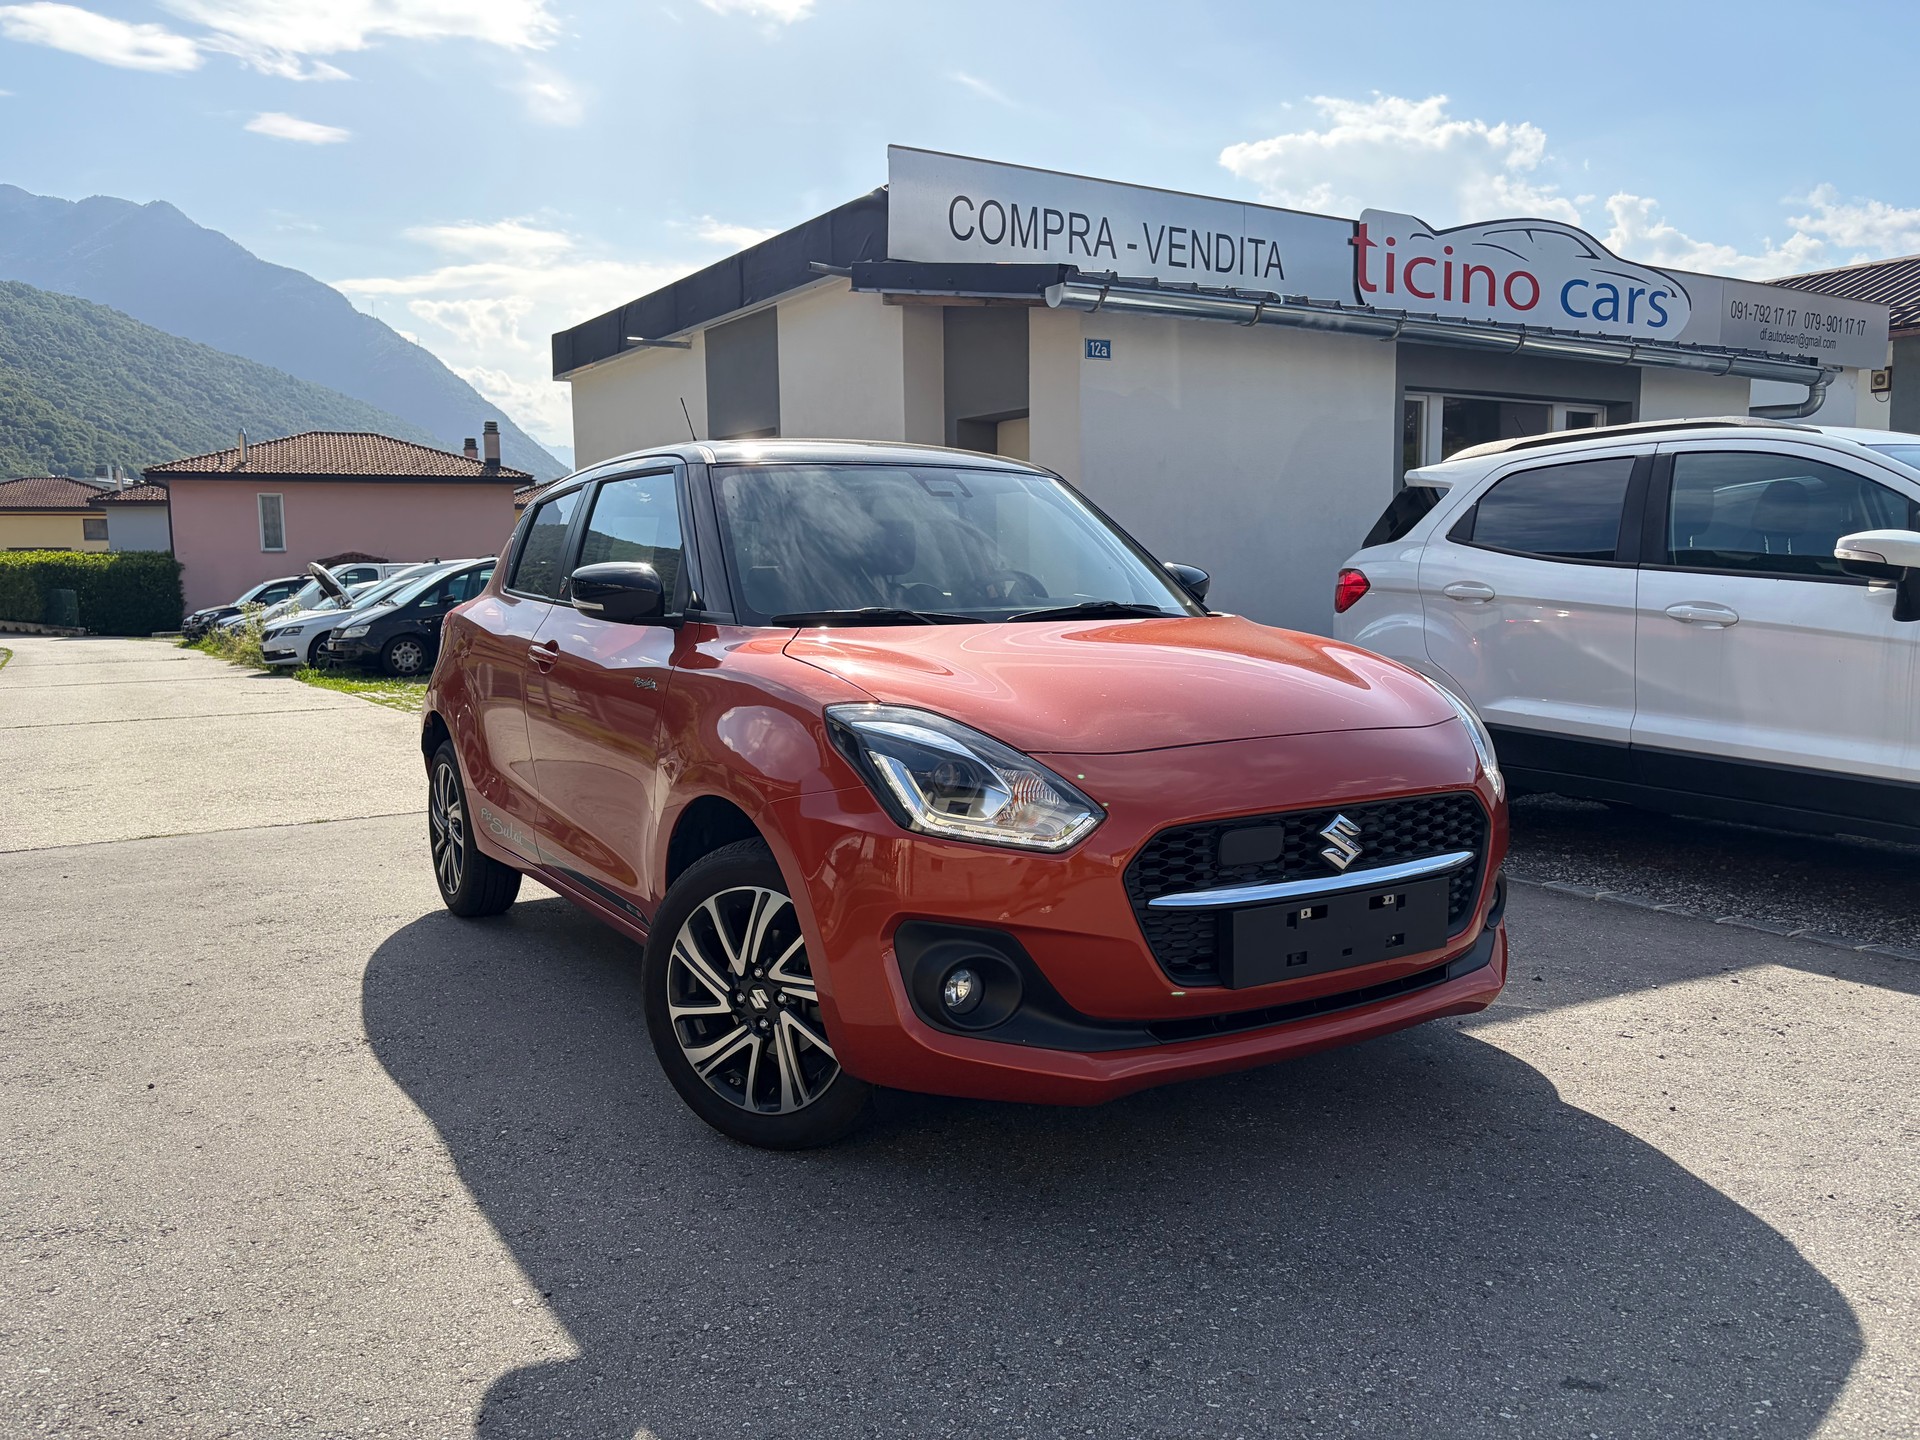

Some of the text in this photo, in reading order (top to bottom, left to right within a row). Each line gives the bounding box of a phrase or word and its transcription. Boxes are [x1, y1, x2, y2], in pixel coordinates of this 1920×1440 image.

[948, 195, 1118, 260] COMPRA
[1143, 222, 1285, 281] VENDITA
[1352, 223, 1669, 328] ticino cars
[1730, 300, 1771, 323] 091-792
[1773, 307, 1784, 325] 17
[1787, 309, 1797, 327] 17
[1090, 341, 1108, 357] 12a
